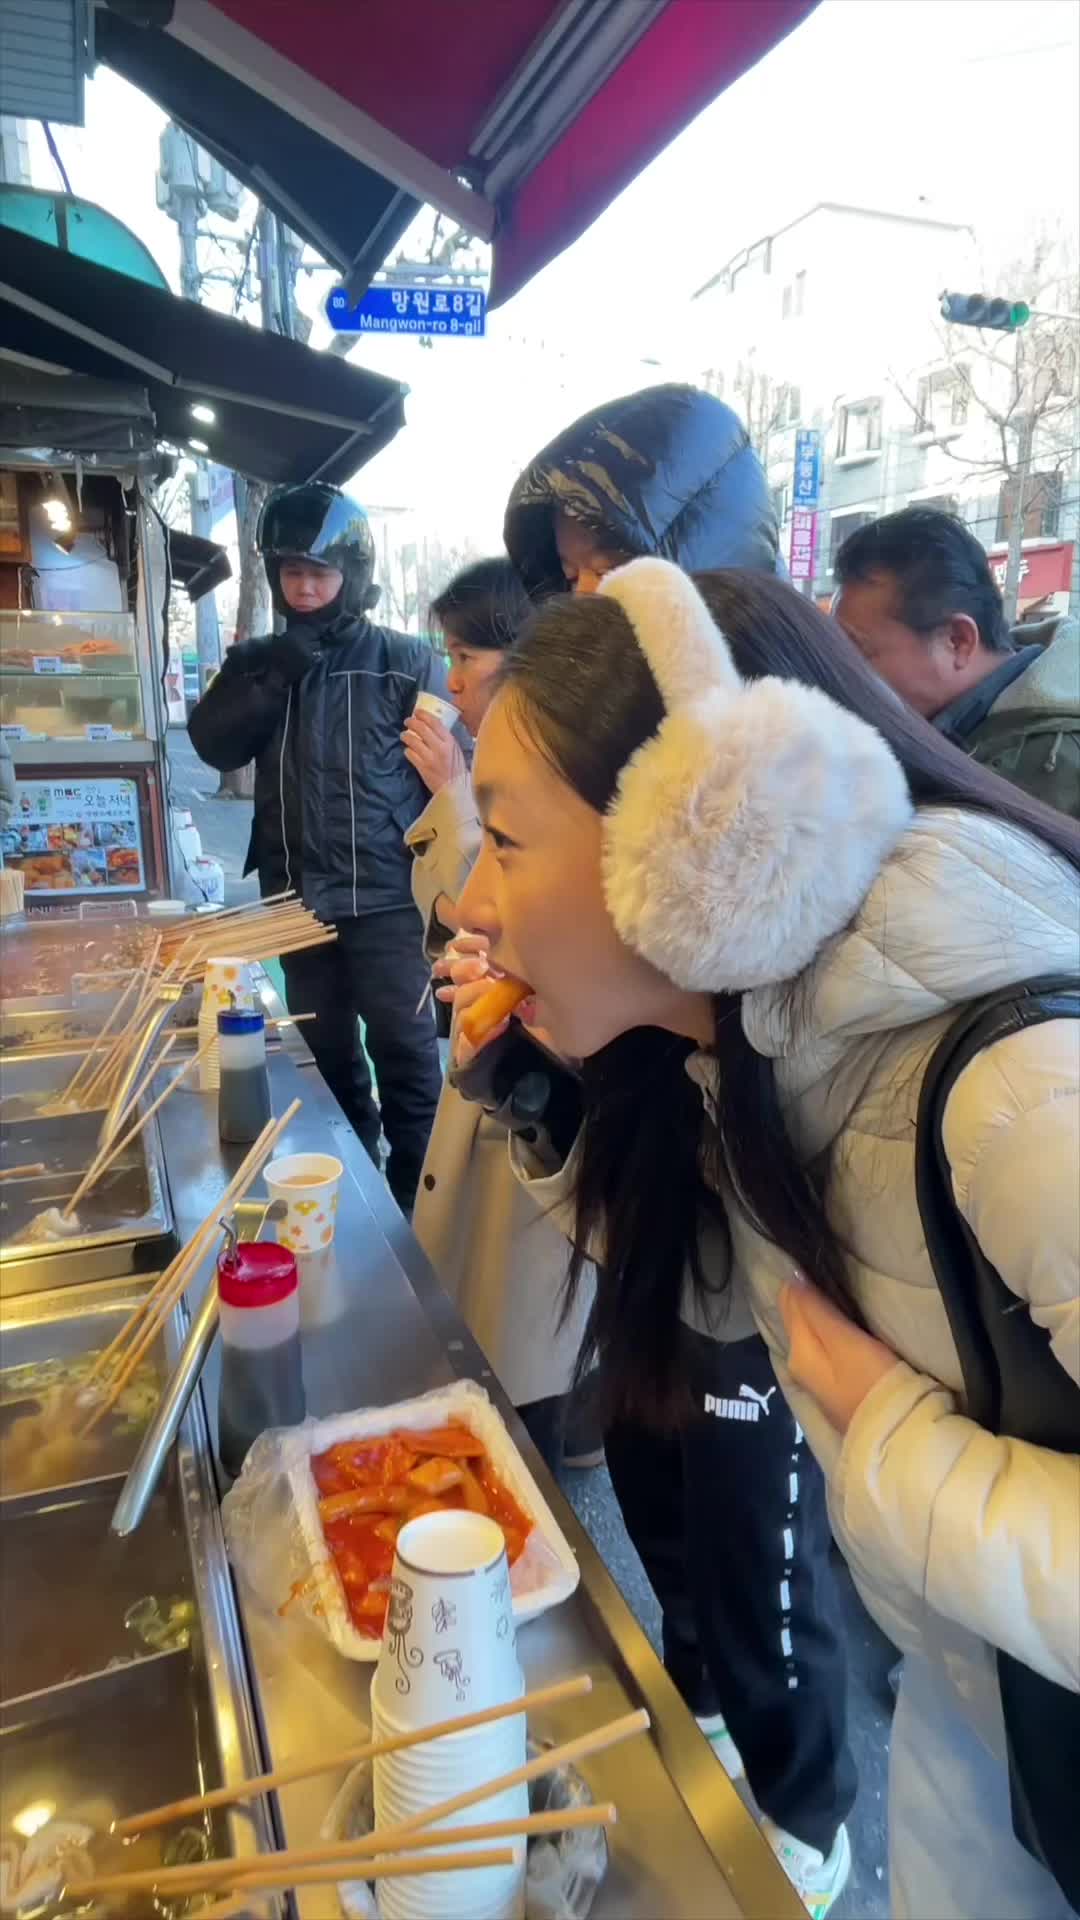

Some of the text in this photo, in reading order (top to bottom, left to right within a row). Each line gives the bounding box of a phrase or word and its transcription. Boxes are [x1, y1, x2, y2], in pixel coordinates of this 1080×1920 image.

[391, 290, 482, 317] 망원로8길
[360, 314, 481, 336] Mangwon-ro 8-gil
[704, 1393, 760, 1422] PUMA
